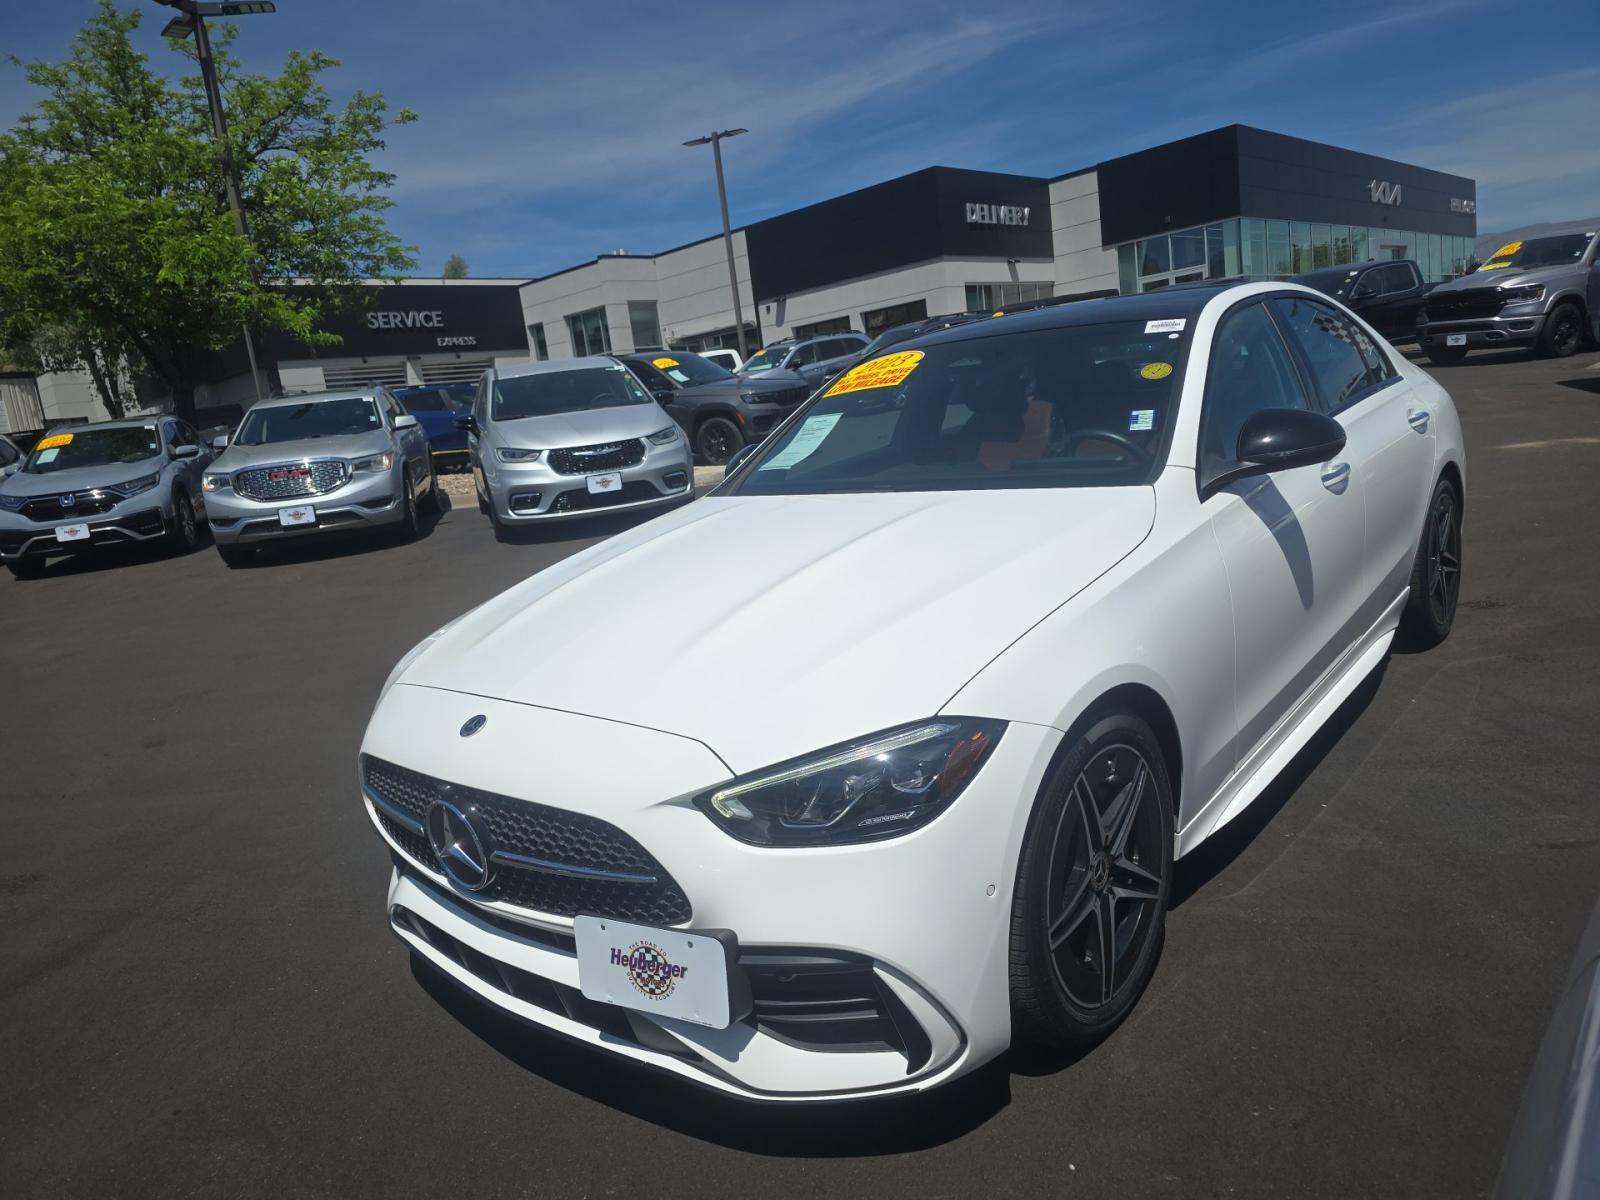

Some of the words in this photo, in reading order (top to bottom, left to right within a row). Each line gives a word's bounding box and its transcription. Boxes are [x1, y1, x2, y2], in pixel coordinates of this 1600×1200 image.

[966, 202, 1030, 225] DELIVERY
[366, 310, 444, 329] SERVICE
[437, 336, 477, 346] EXPRESS
